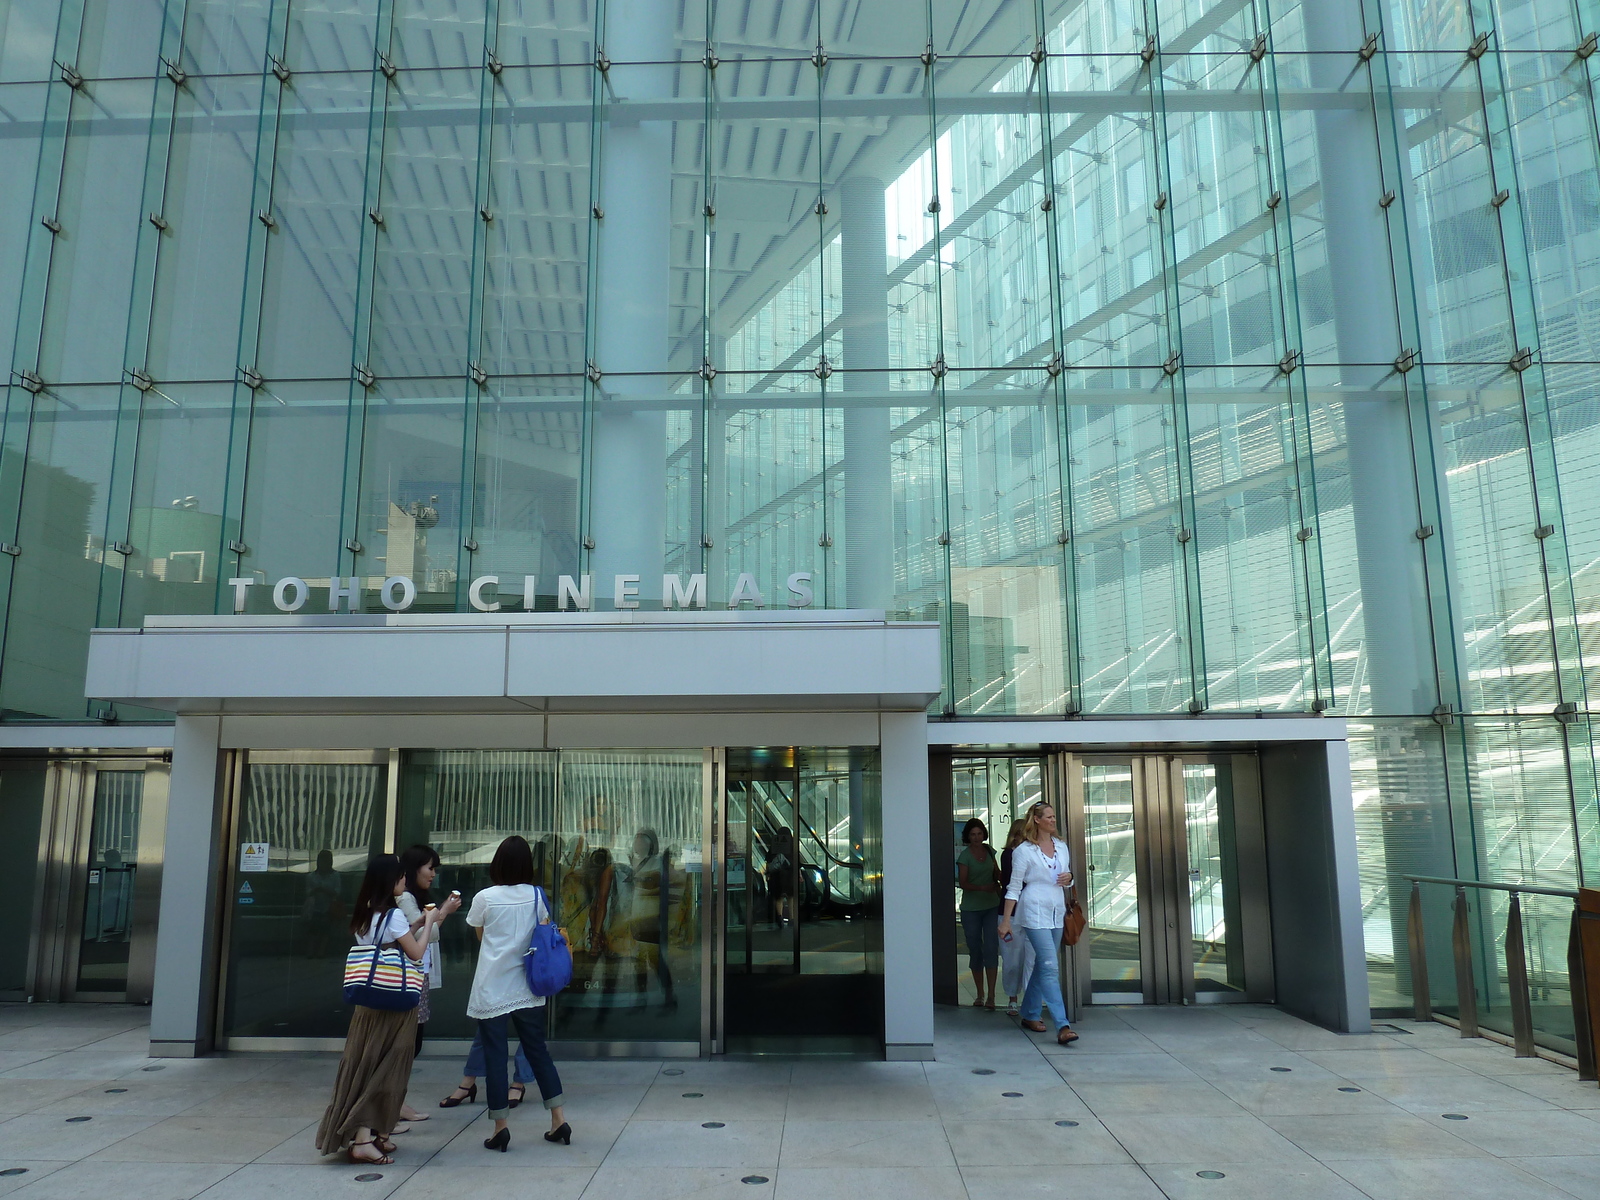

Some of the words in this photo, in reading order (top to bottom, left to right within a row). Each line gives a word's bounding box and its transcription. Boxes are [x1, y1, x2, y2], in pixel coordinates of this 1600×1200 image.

[228, 576, 417, 612] TOHO
[468, 572, 814, 612] CINEMAS
[583, 980, 600, 990] 6.4
